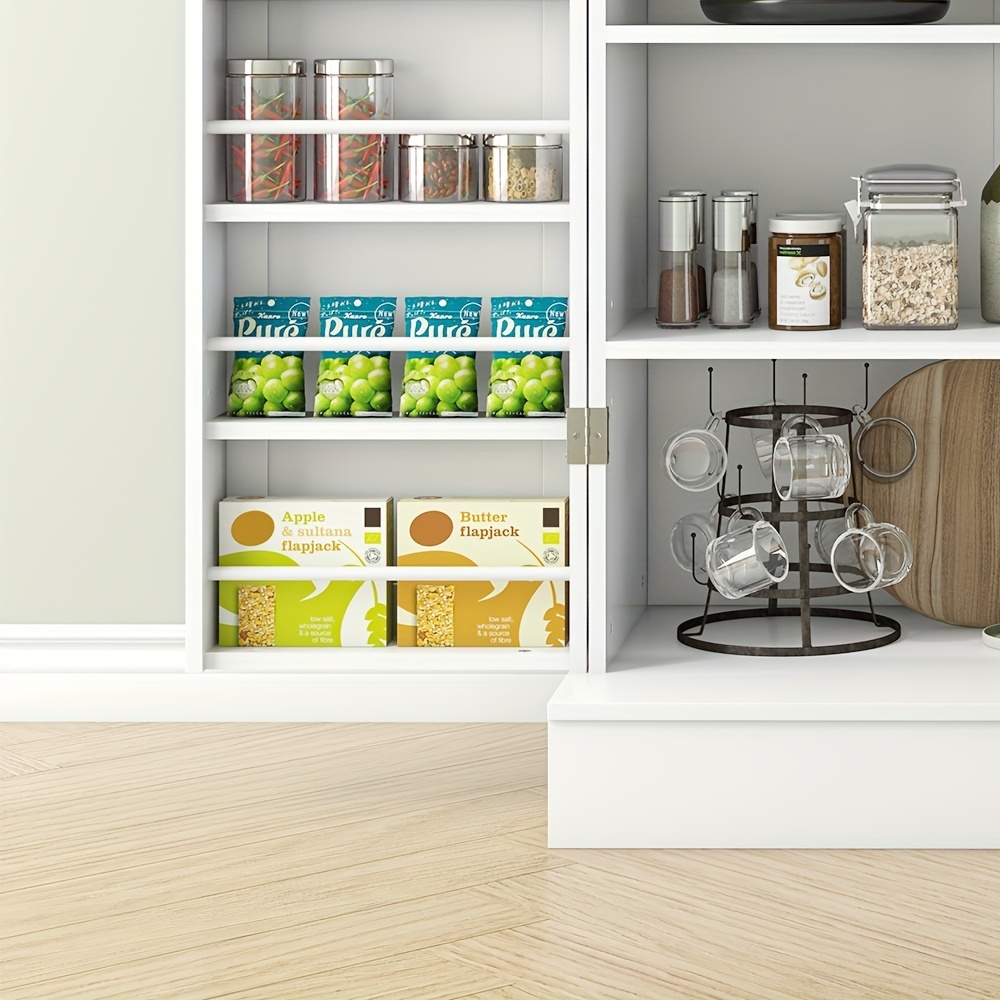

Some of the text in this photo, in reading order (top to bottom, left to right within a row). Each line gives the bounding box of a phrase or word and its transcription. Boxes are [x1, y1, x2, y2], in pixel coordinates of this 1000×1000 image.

[281, 511, 326, 525] Apple
[460, 511, 508, 522] Butter
[281, 526, 352, 537] & sultana
[460, 526, 520, 540] flapjack
[281, 541, 341, 554] flapjack
